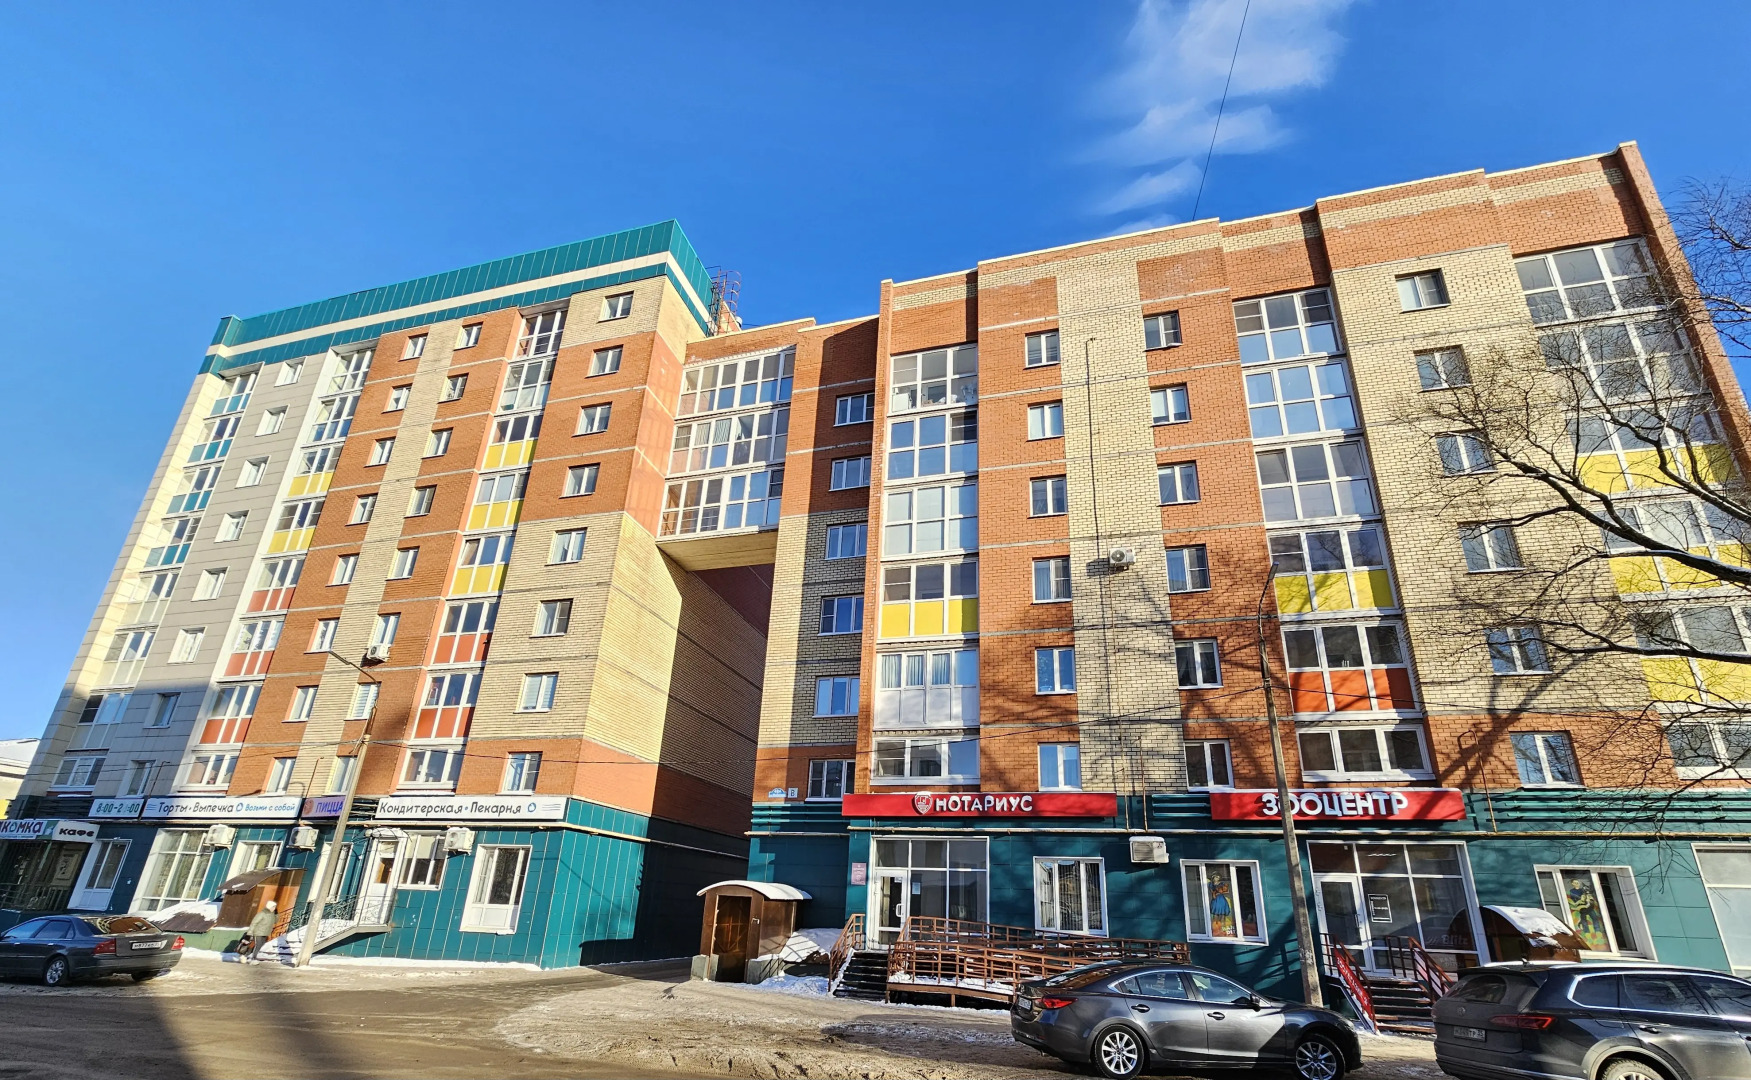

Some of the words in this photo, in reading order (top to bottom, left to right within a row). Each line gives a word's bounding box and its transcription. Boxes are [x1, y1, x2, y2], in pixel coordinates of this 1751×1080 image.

[96, 802, 140, 813] 8:00-2:00
[158, 802, 188, 815] Торты
[193, 802, 234, 813] Выпечка
[245, 804, 268, 812] Возьми
[274, 803, 295, 811] собой
[315, 801, 344, 814] ПИЦЦА
[379, 802, 463, 817] Кондитерская
[470, 802, 521, 817] Пекарня
[935, 795, 1033, 812] НОТАРИУС
[1262, 792, 1408, 817] ЗООЦЕНТР
